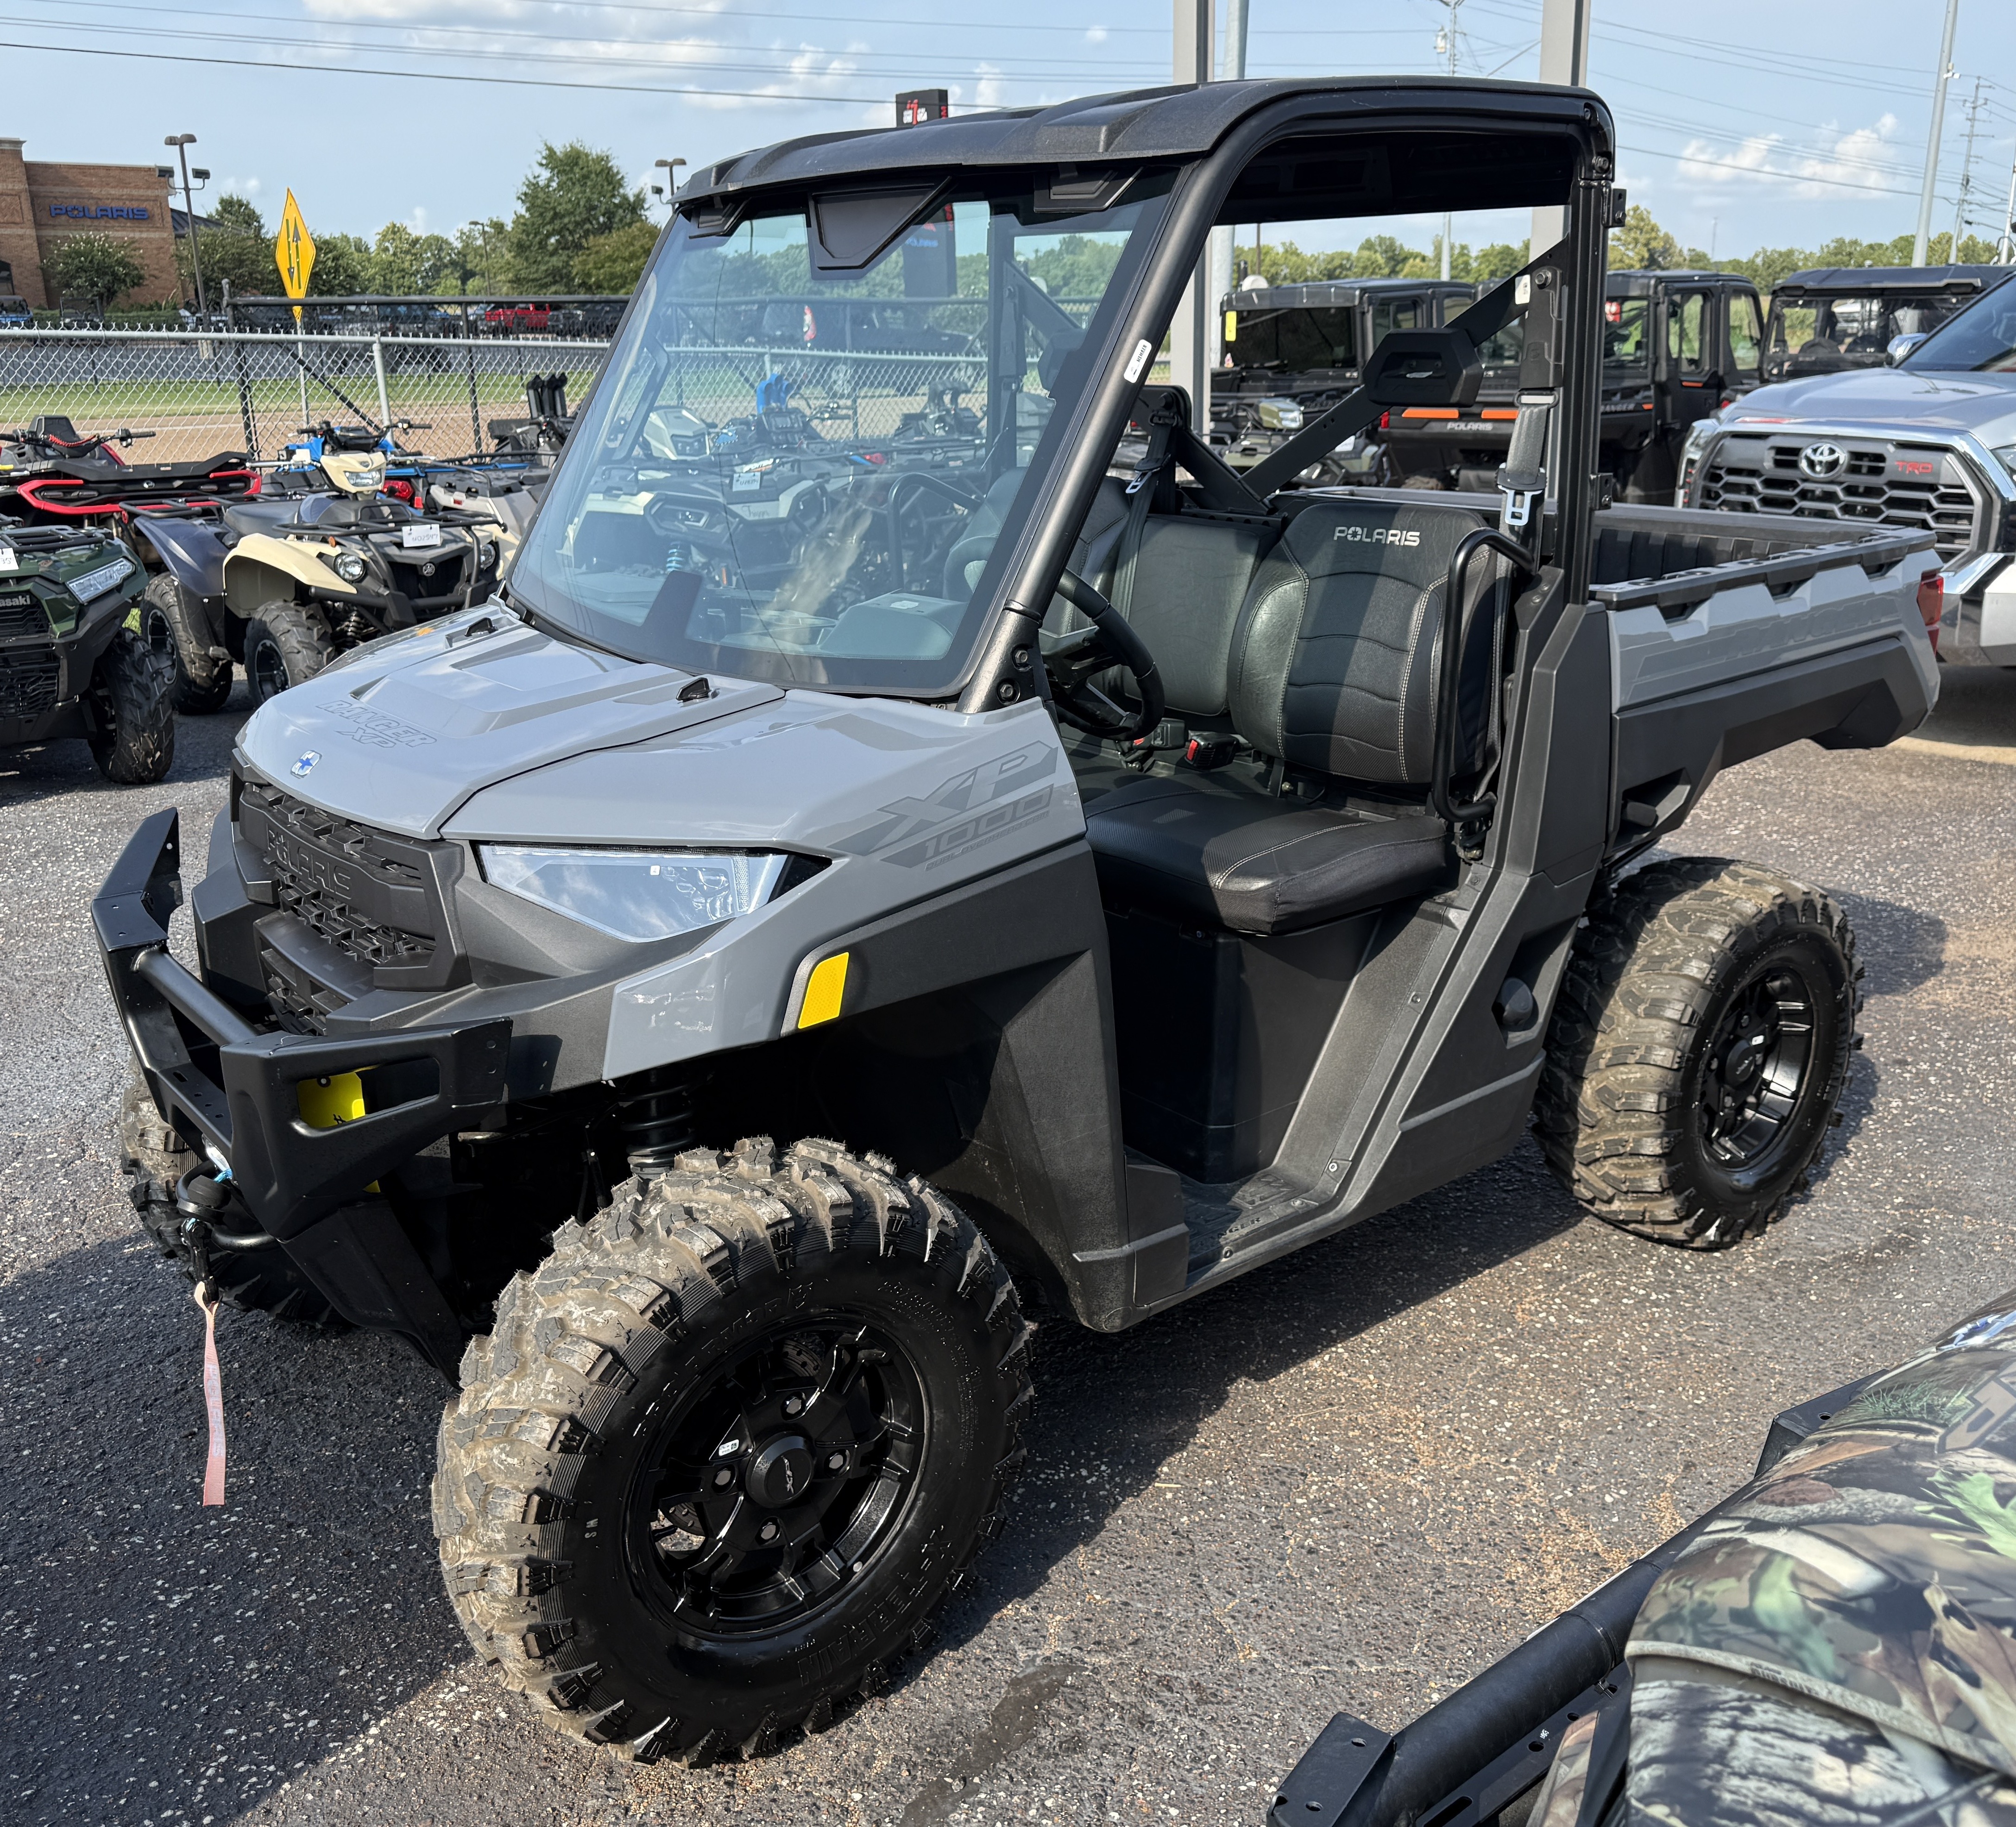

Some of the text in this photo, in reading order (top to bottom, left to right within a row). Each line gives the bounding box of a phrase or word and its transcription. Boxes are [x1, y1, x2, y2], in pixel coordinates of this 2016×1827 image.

[50, 204, 149, 219] POLARIS
[1446, 422, 1493, 431] POLARIS
[1895, 460, 1934, 475] TRD
[1333, 526, 1421, 547] POLARIS
[315, 700, 437, 748] RANGER
[334, 727, 397, 748] XP
[843, 740, 1058, 856] XP
[917, 784, 1054, 862] 1000
[266, 823, 352, 900] POLARIS
